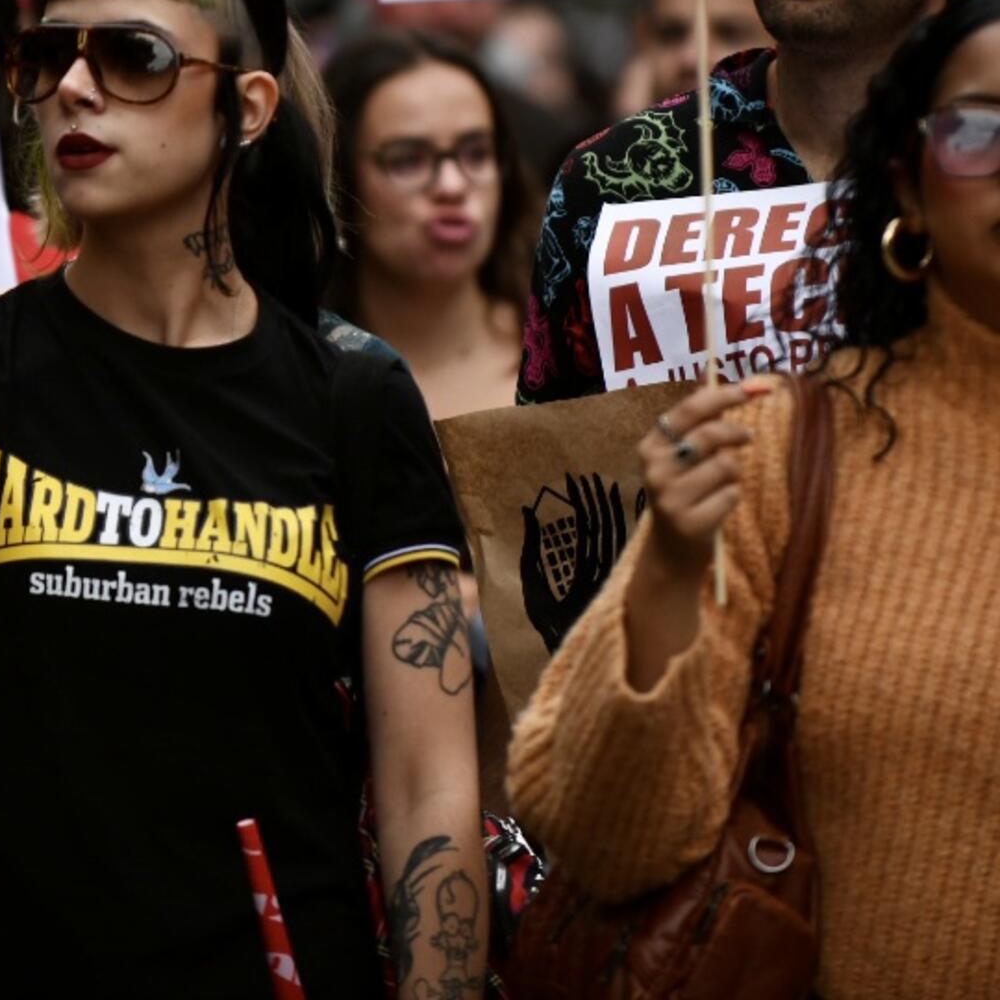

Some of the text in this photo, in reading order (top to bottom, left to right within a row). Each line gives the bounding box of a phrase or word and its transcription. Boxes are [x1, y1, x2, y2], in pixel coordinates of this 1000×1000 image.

[604, 201, 848, 276] DEREC
[609, 282, 663, 372] A
[665, 257, 836, 354] TEC
[29, 565, 273, 617] suburban rebels
